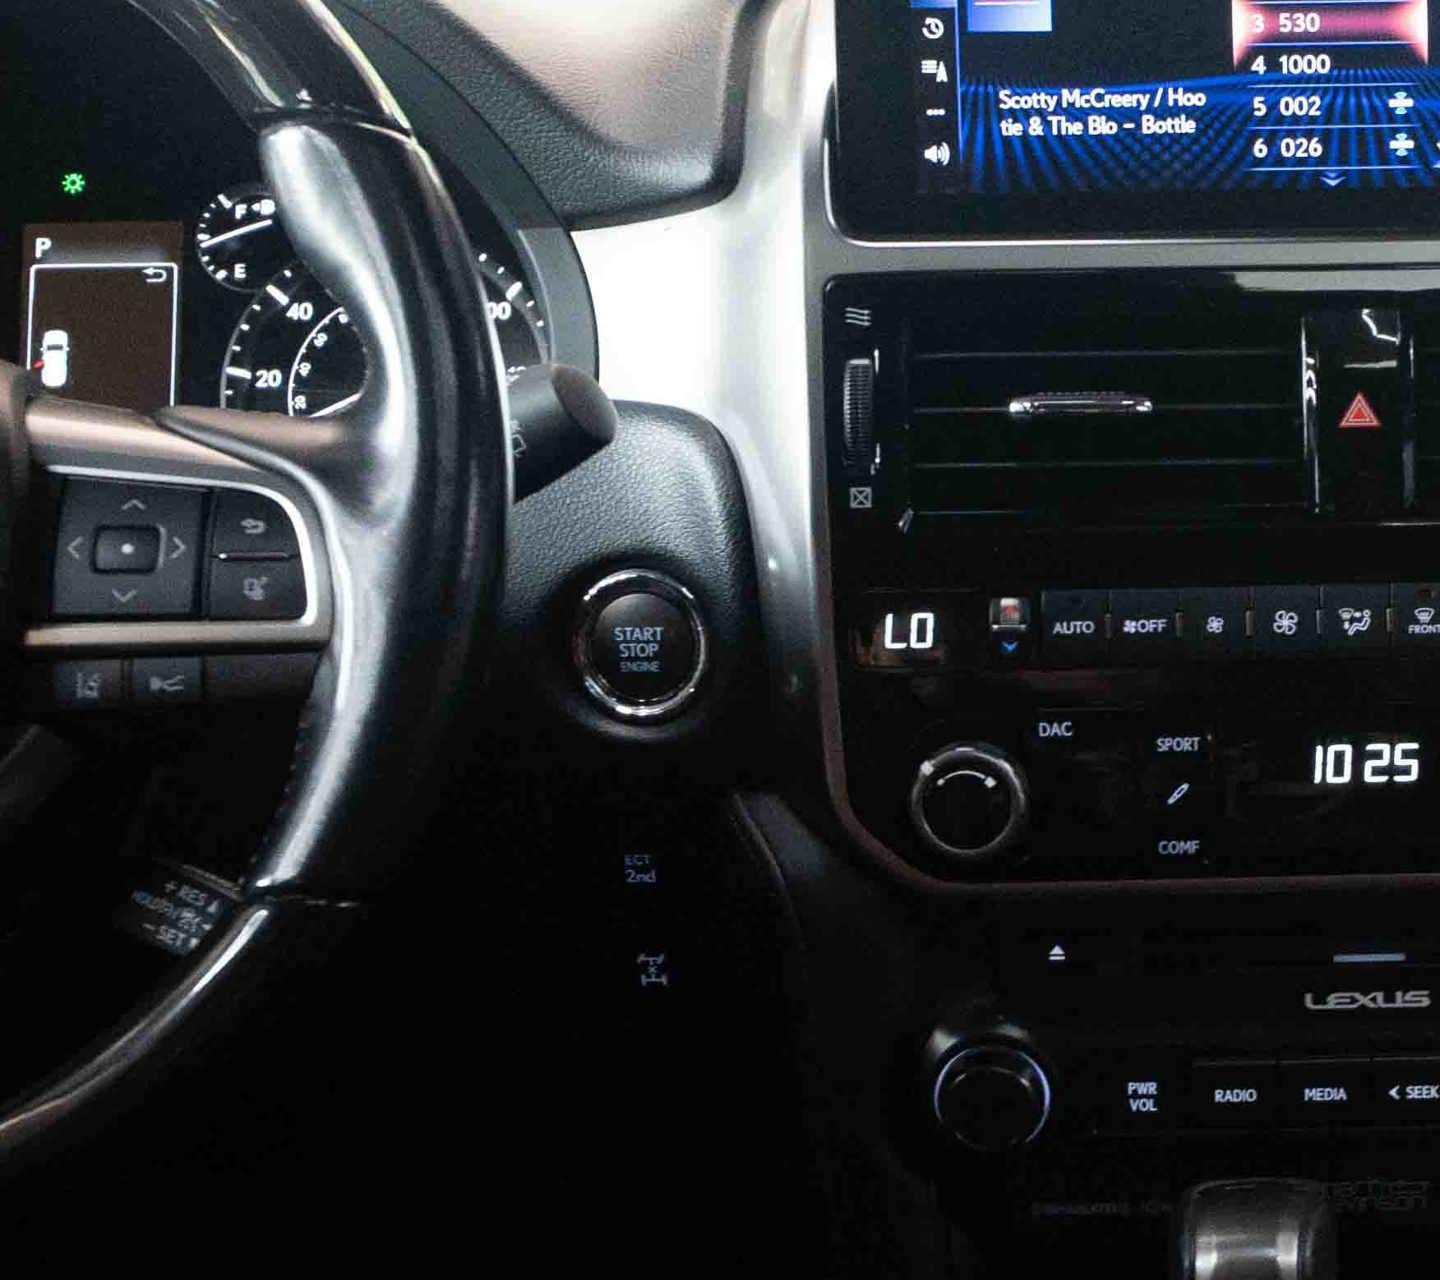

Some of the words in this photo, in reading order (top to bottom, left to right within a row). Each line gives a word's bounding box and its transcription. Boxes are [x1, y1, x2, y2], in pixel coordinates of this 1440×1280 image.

[1250, 12, 1267, 35] 3
[1277, 12, 1321, 33] 530
[1250, 54, 1267, 76] 4
[1278, 53, 1332, 76] 1000
[998, 88, 1059, 113] Scotty
[1060, 87, 1149, 111] McCreery
[1167, 86, 1207, 107] Hoo
[1252, 95, 1267, 117] 5
[1279, 95, 1322, 117] 002
[999, 117, 1024, 137] tie
[1027, 115, 1045, 136] &
[1047, 115, 1084, 136] The
[1087, 114, 1119, 136] Blo
[1141, 113, 1197, 135] Bottle
[1252, 137, 1268, 159] 6
[1280, 136, 1323, 158] 026
[235, 204, 247, 220] F
[35, 237, 52, 258] P
[234, 264, 246, 279] E
[286, 301, 314, 321] 40
[254, 369, 282, 388] 20
[613, 626, 664, 641] START
[883, 612, 935, 650] LO
[1052, 620, 1095, 635] AUTO
[1138, 618, 1168, 633] OFF
[619, 642, 659, 658] STOP
[1038, 721, 1073, 737] DAC
[1156, 736, 1201, 753] SPORT
[1158, 839, 1200, 855] COMF
[624, 869, 656, 883] 2nd
[1304, 990, 1431, 1010] LEXUS
[1127, 1081, 1158, 1095] PWR
[1214, 1088, 1258, 1103] RADIO
[1303, 1087, 1348, 1102] MEDIA
[1405, 1084, 1440, 1100] SEEK
[1129, 1097, 1158, 1112] VOL
